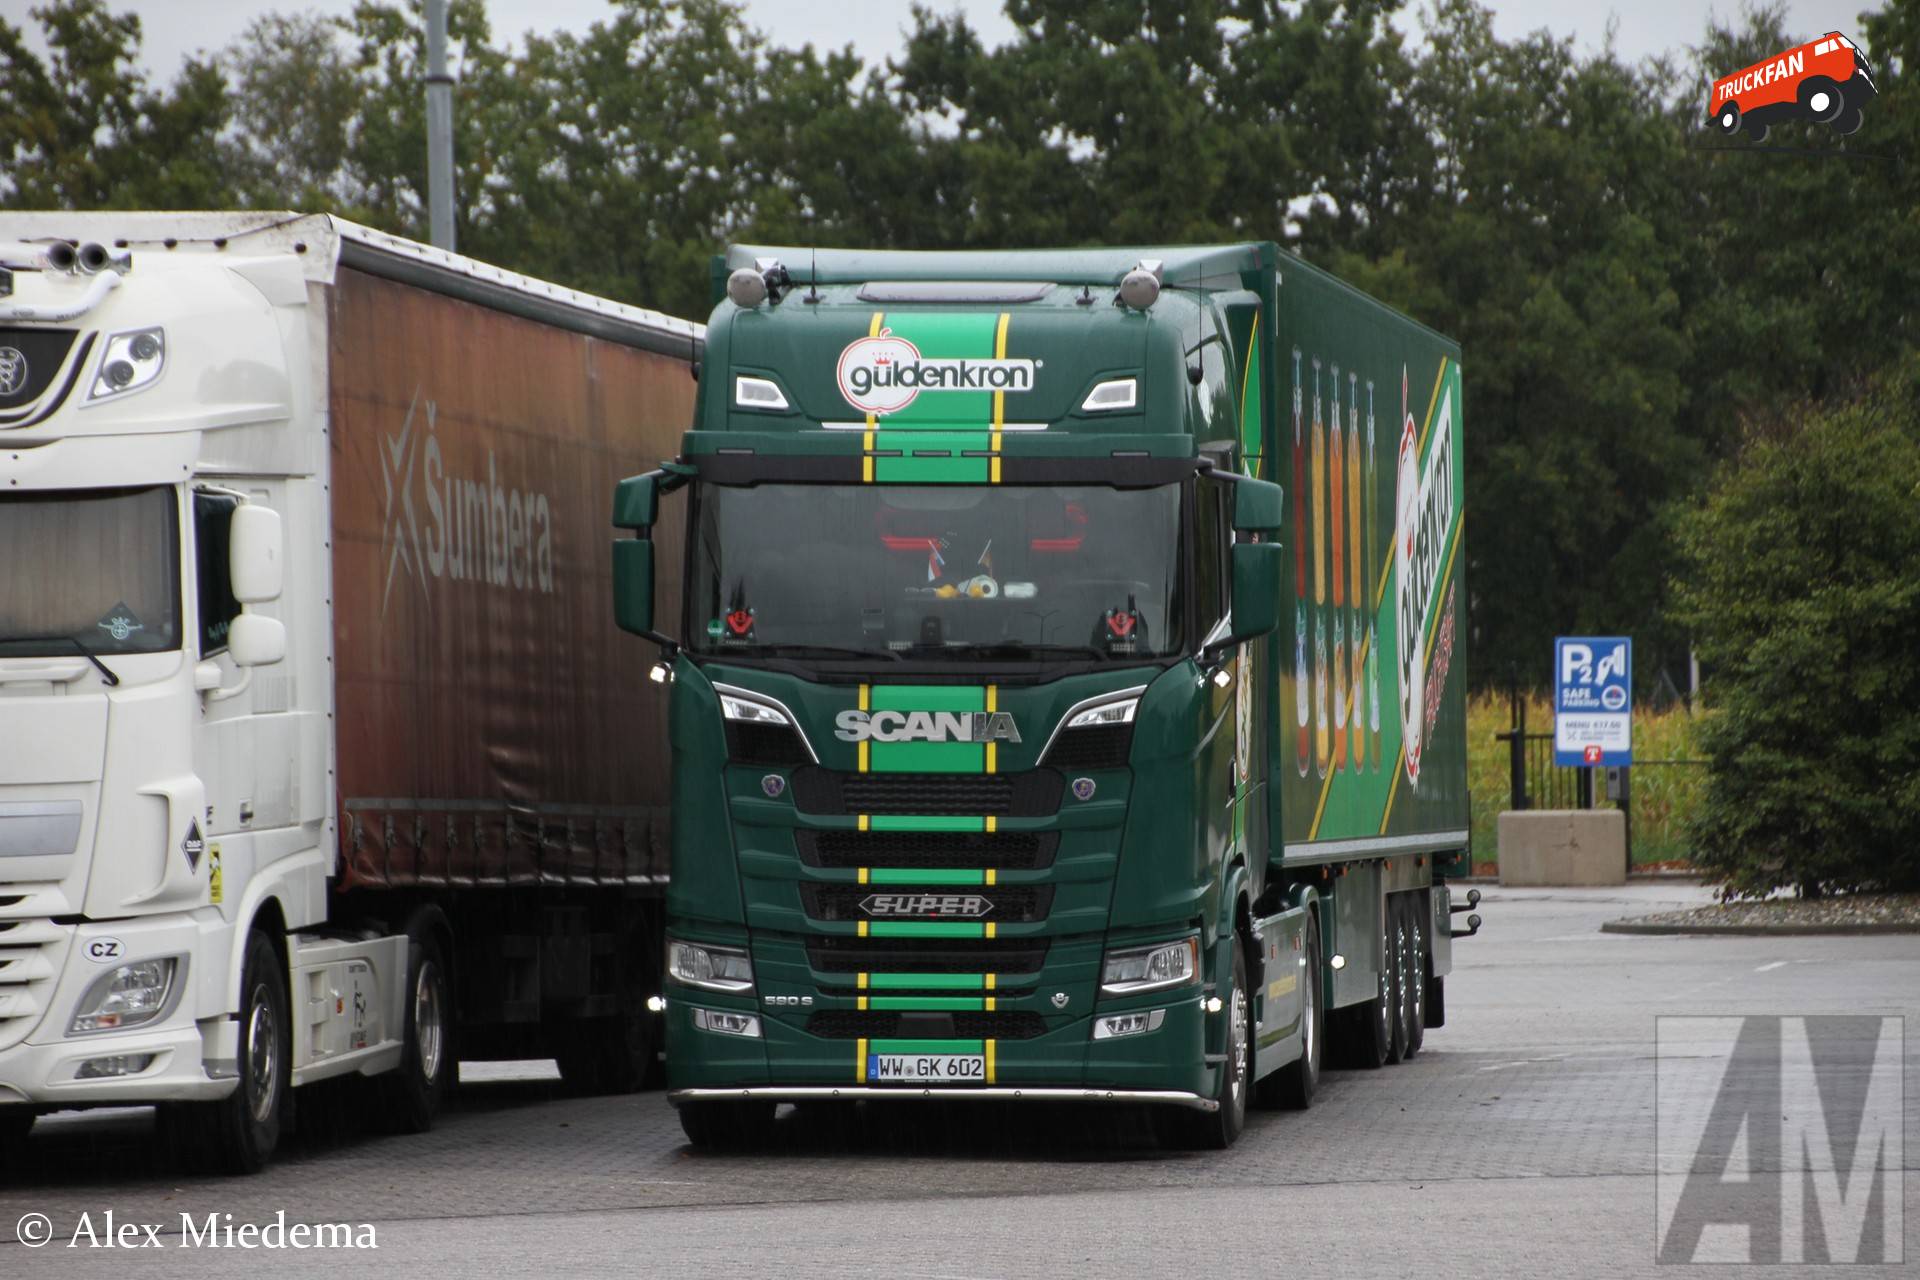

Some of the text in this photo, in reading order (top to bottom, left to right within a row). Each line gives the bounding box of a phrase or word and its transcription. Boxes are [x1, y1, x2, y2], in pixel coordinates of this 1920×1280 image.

[850, 360, 1028, 396] güldenkron
[1562, 687, 1591, 698] SAFE
[834, 709, 1022, 743] SCANIA
[872, 897, 981, 913] SUPER
[90, 942, 118, 957] CZ
[879, 1058, 982, 1076] WW GK 602
